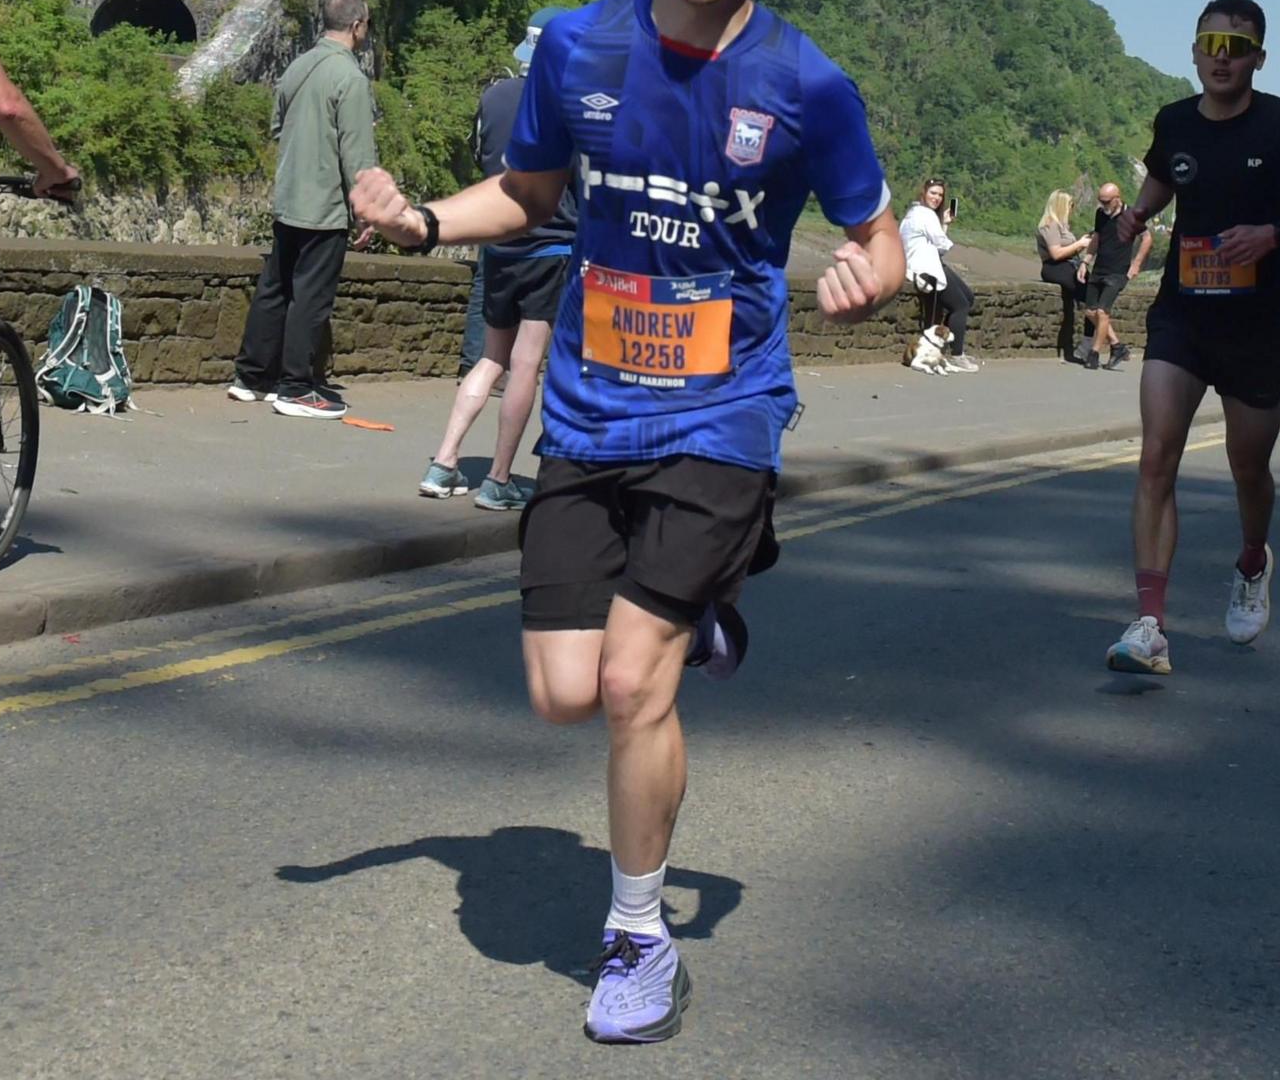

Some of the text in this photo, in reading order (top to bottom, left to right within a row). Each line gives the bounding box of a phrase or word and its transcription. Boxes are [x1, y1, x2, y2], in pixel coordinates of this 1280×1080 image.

[583, 110, 612, 121] umbro
[1247, 158, 1263, 168] KP
[630, 211, 701, 249] TOUR
[612, 305, 696, 339] ANDREW
[620, 338, 686, 370] 12258
[619, 371, 686, 388] HALF MARATHON
